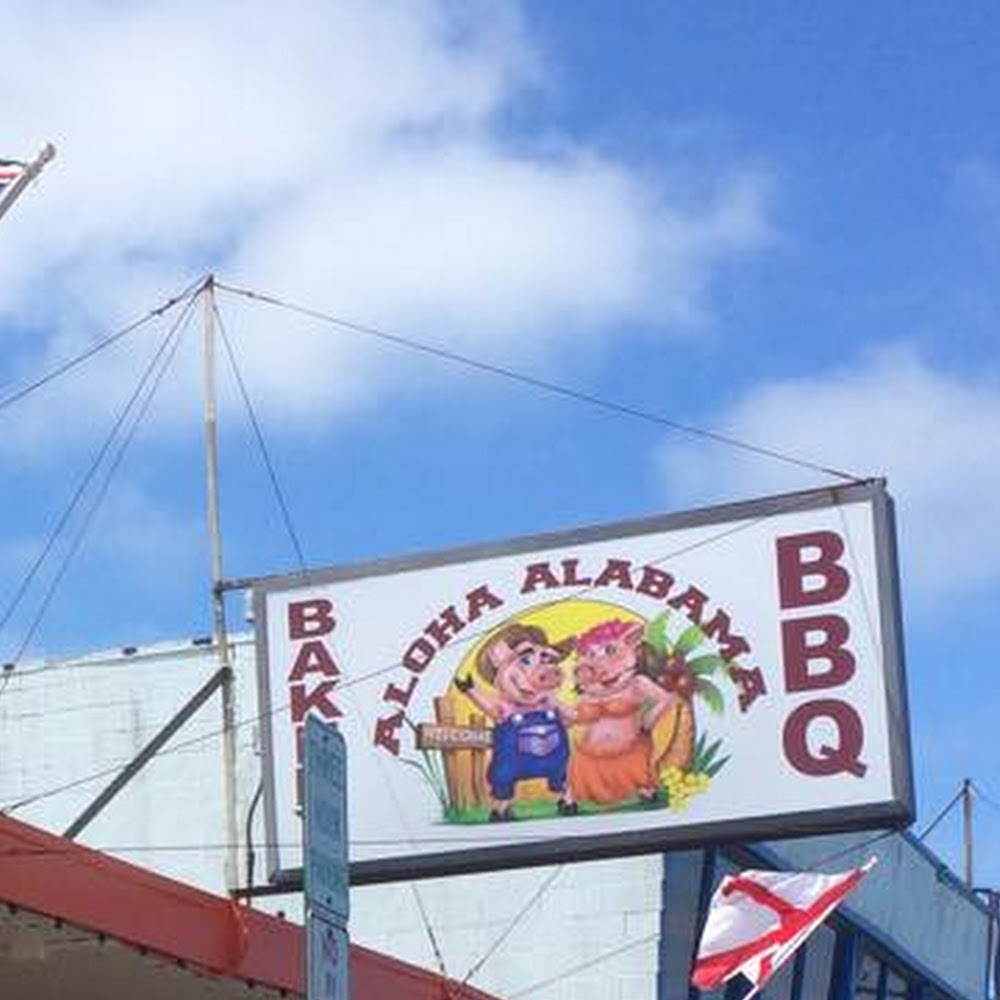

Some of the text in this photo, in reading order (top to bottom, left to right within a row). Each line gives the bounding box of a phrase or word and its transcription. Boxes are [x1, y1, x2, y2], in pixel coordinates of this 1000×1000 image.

[374, 558, 767, 756] ALOHA ALABAMA
[776, 530, 867, 778] BBQ
